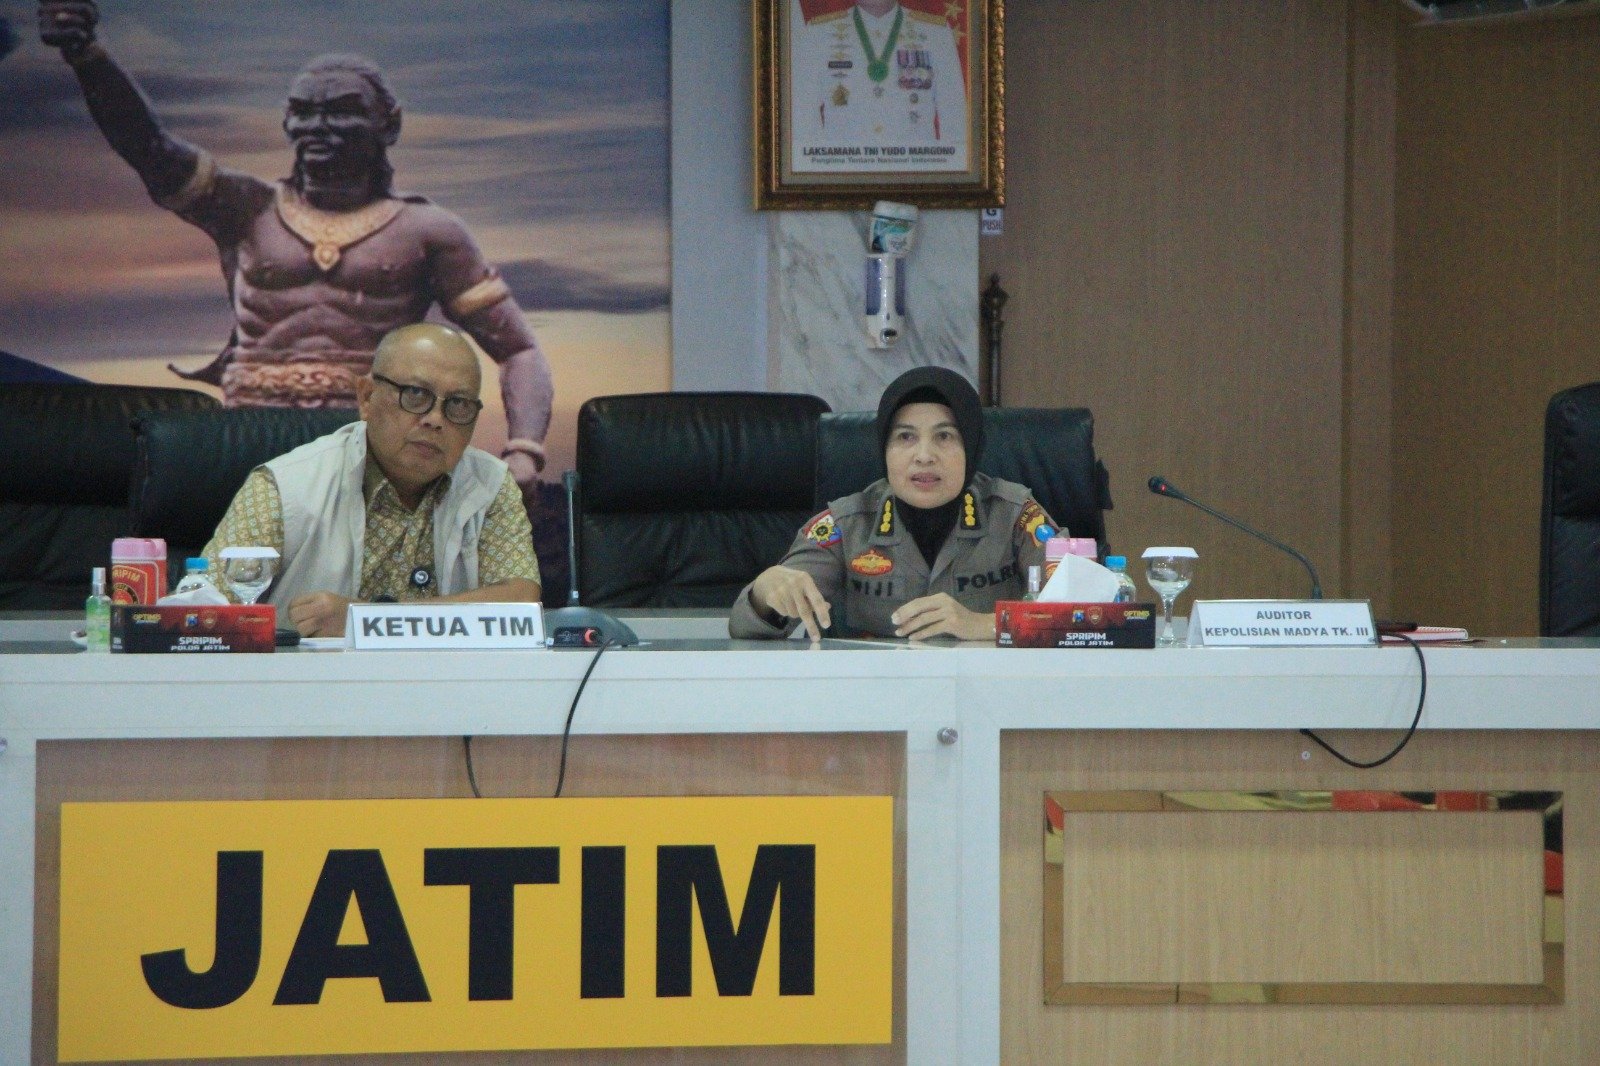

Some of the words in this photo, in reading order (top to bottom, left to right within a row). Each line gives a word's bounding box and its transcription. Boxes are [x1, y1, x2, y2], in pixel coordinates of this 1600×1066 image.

[803, 146, 861, 156] LAKSAMANA
[864, 146, 878, 156] TNI
[881, 146, 906, 156] YUDO
[908, 146, 956, 156] MARGONO
[1256, 610, 1312, 620] AUDITOR
[362, 616, 469, 637] KETUA
[478, 616, 534, 636] TIM
[1066, 632, 1107, 640] SPRIPIM
[1205, 627, 1280, 637] KEPOLISIAN
[1284, 627, 1327, 636] MADYA
[1332, 627, 1352, 636] TK.
[1356, 627, 1369, 636] III
[178, 636, 222, 645] SPRIPIM
[140, 843, 816, 1010] JATIM
